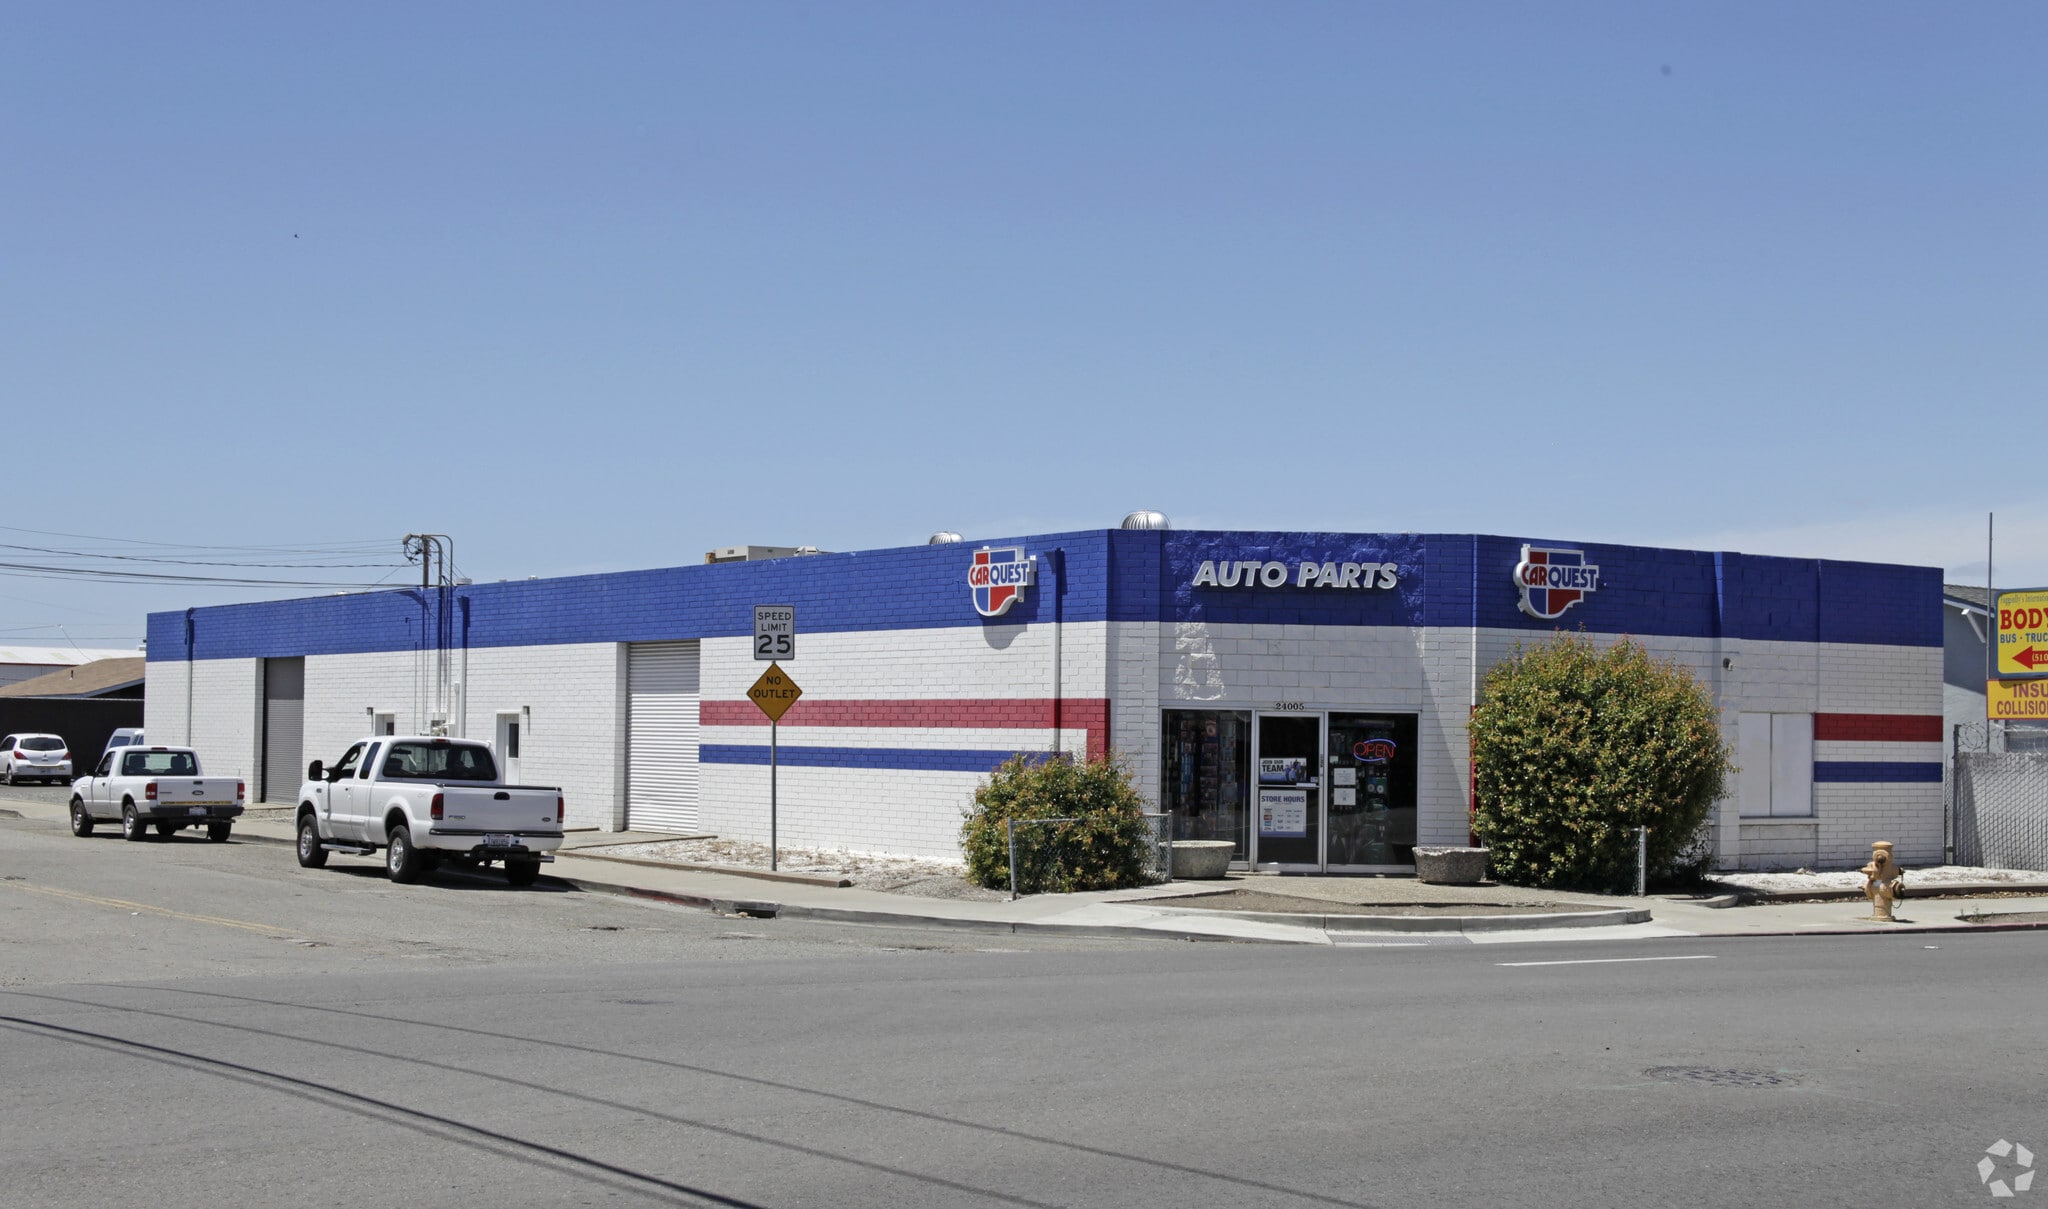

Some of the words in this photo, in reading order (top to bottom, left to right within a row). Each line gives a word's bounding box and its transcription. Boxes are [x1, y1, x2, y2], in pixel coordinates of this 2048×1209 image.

[970, 563, 1028, 585] CARQUEST
[1192, 560, 1288, 587] AUTO
[1297, 561, 1398, 589] PARTS
[1521, 565, 1597, 588] CARQUEST
[757, 612, 791, 620] SPEED
[761, 623, 787, 631] LIMIT
[758, 634, 791, 654] 25
[2000, 633, 2017, 643] BUS
[766, 676, 782, 685] NO
[753, 689, 795, 698] OUTLET
[1275, 702, 1305, 711] 24005
[1997, 700, 2048, 715] COLLISIO
[1353, 742, 1395, 758] OPEN
